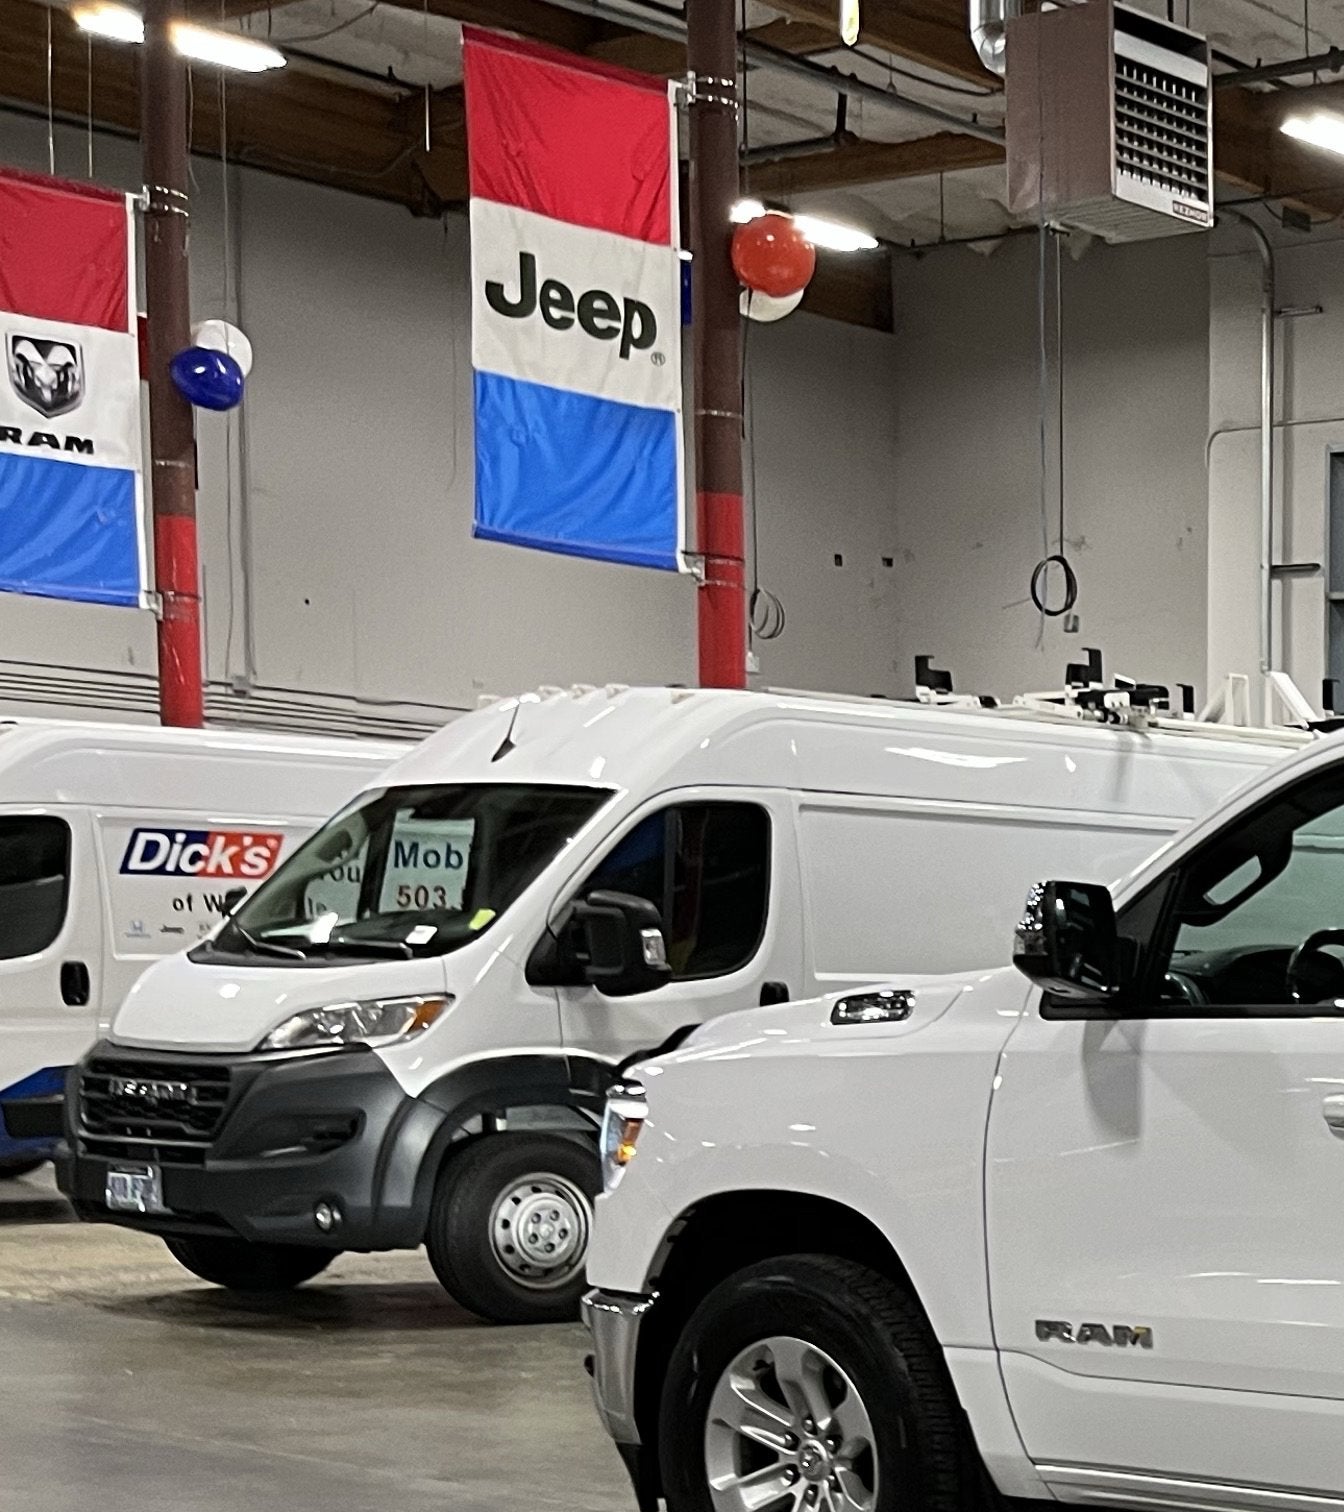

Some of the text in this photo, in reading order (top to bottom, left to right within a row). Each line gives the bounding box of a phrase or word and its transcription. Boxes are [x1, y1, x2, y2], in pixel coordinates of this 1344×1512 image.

[484, 251, 657, 361] Jeep
[0, 426, 94, 455] RAM
[128, 831, 271, 876] Dick's
[393, 839, 464, 869] Mob
[172, 892, 193, 912] of
[396, 884, 447, 911] 503
[1035, 1319, 1153, 1349] RAM
